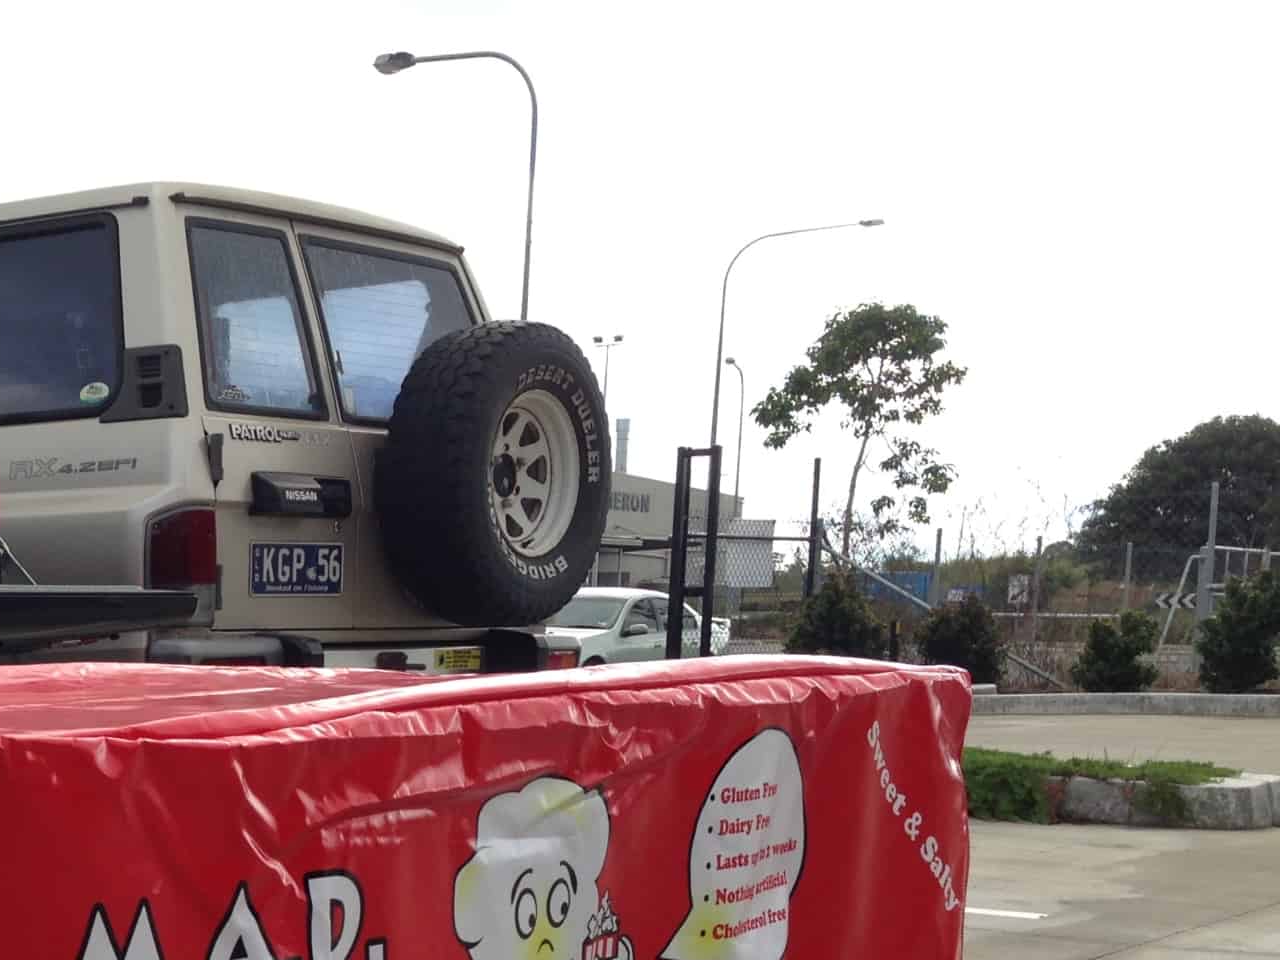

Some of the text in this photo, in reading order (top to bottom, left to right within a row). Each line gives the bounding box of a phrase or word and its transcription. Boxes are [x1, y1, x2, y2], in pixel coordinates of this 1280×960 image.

[518, 364, 600, 483] DESERT DUELER
[229, 423, 282, 443] PATROL
[285, 489, 318, 502] NISSAN
[720, 787, 761, 804] Gluten
[867, 720, 960, 911] Sweet & Salty
[718, 818, 753, 836] Dairy
[716, 853, 750, 871] Lasts
[767, 908, 787, 924] free
